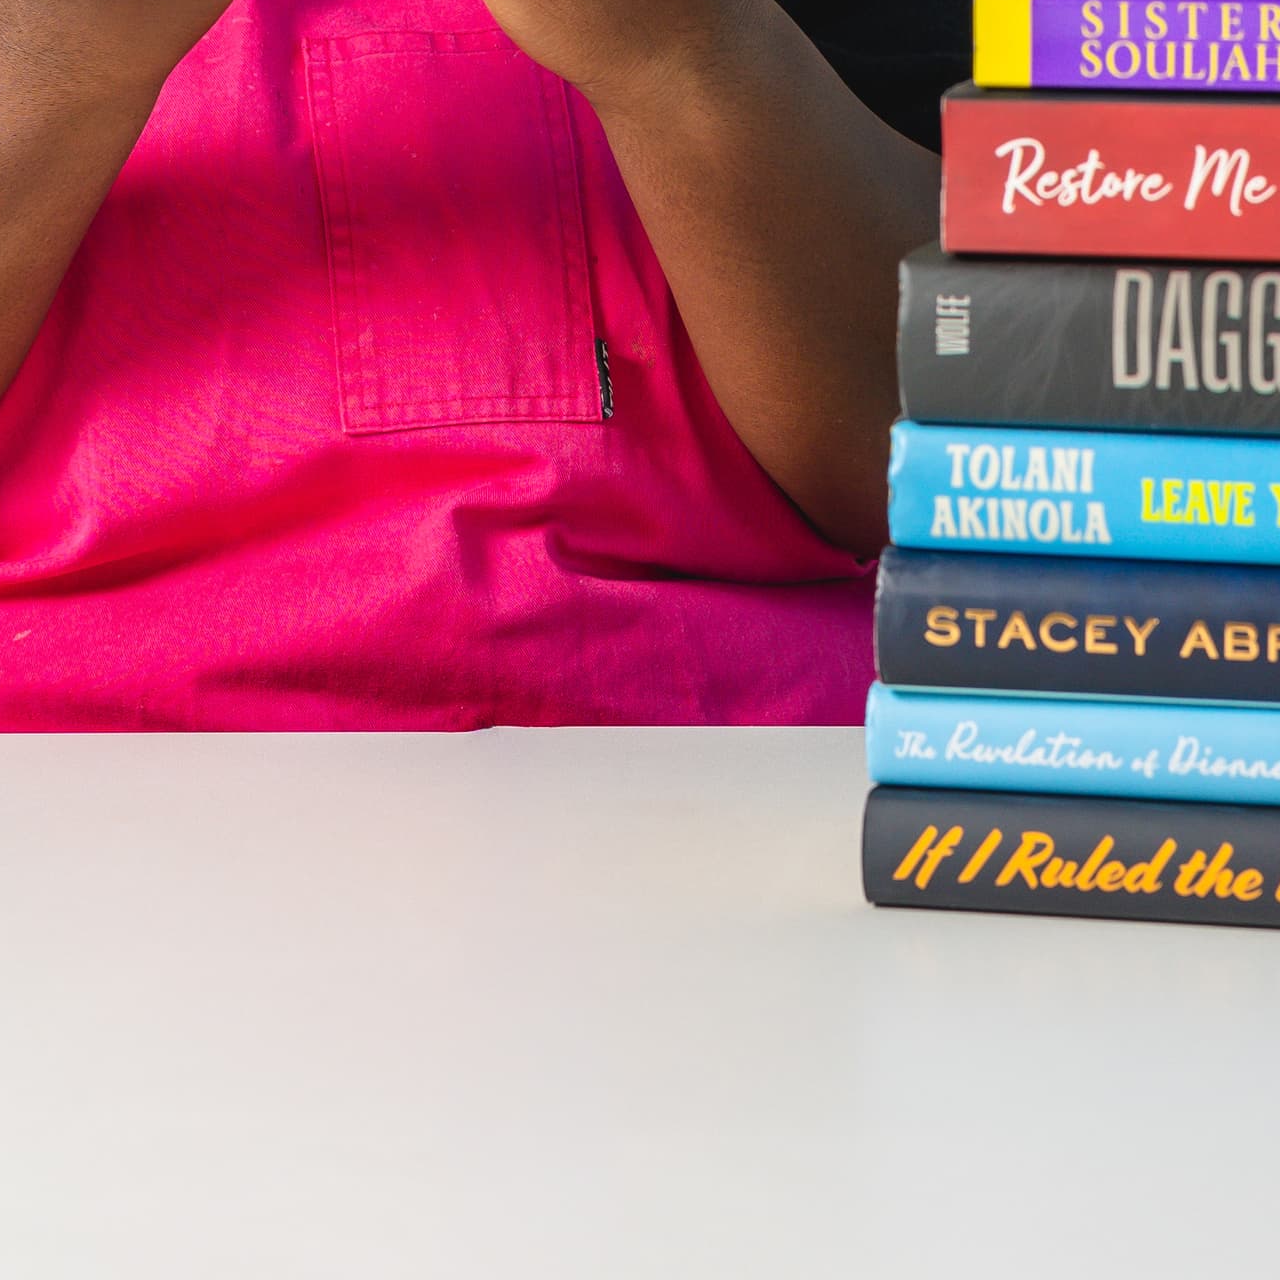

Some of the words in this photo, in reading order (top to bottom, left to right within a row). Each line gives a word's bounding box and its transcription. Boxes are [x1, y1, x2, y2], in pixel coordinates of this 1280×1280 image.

[995, 137, 1172, 214] Restore
[1184, 145, 1276, 216] Me
[935, 294, 971, 356] WOLFE
[947, 444, 1095, 493] TOLANI
[930, 496, 1112, 544] AKINOLA
[1140, 479, 1255, 525] LEAVE
[925, 607, 1161, 656] STACEY
[894, 730, 936, 759] The
[944, 721, 1122, 771] Revelation
[1131, 751, 1159, 778] of
[892, 825, 963, 890] If
[958, 828, 1002, 883] I
[995, 832, 1178, 895] Ruled
[1174, 841, 1265, 901] the
